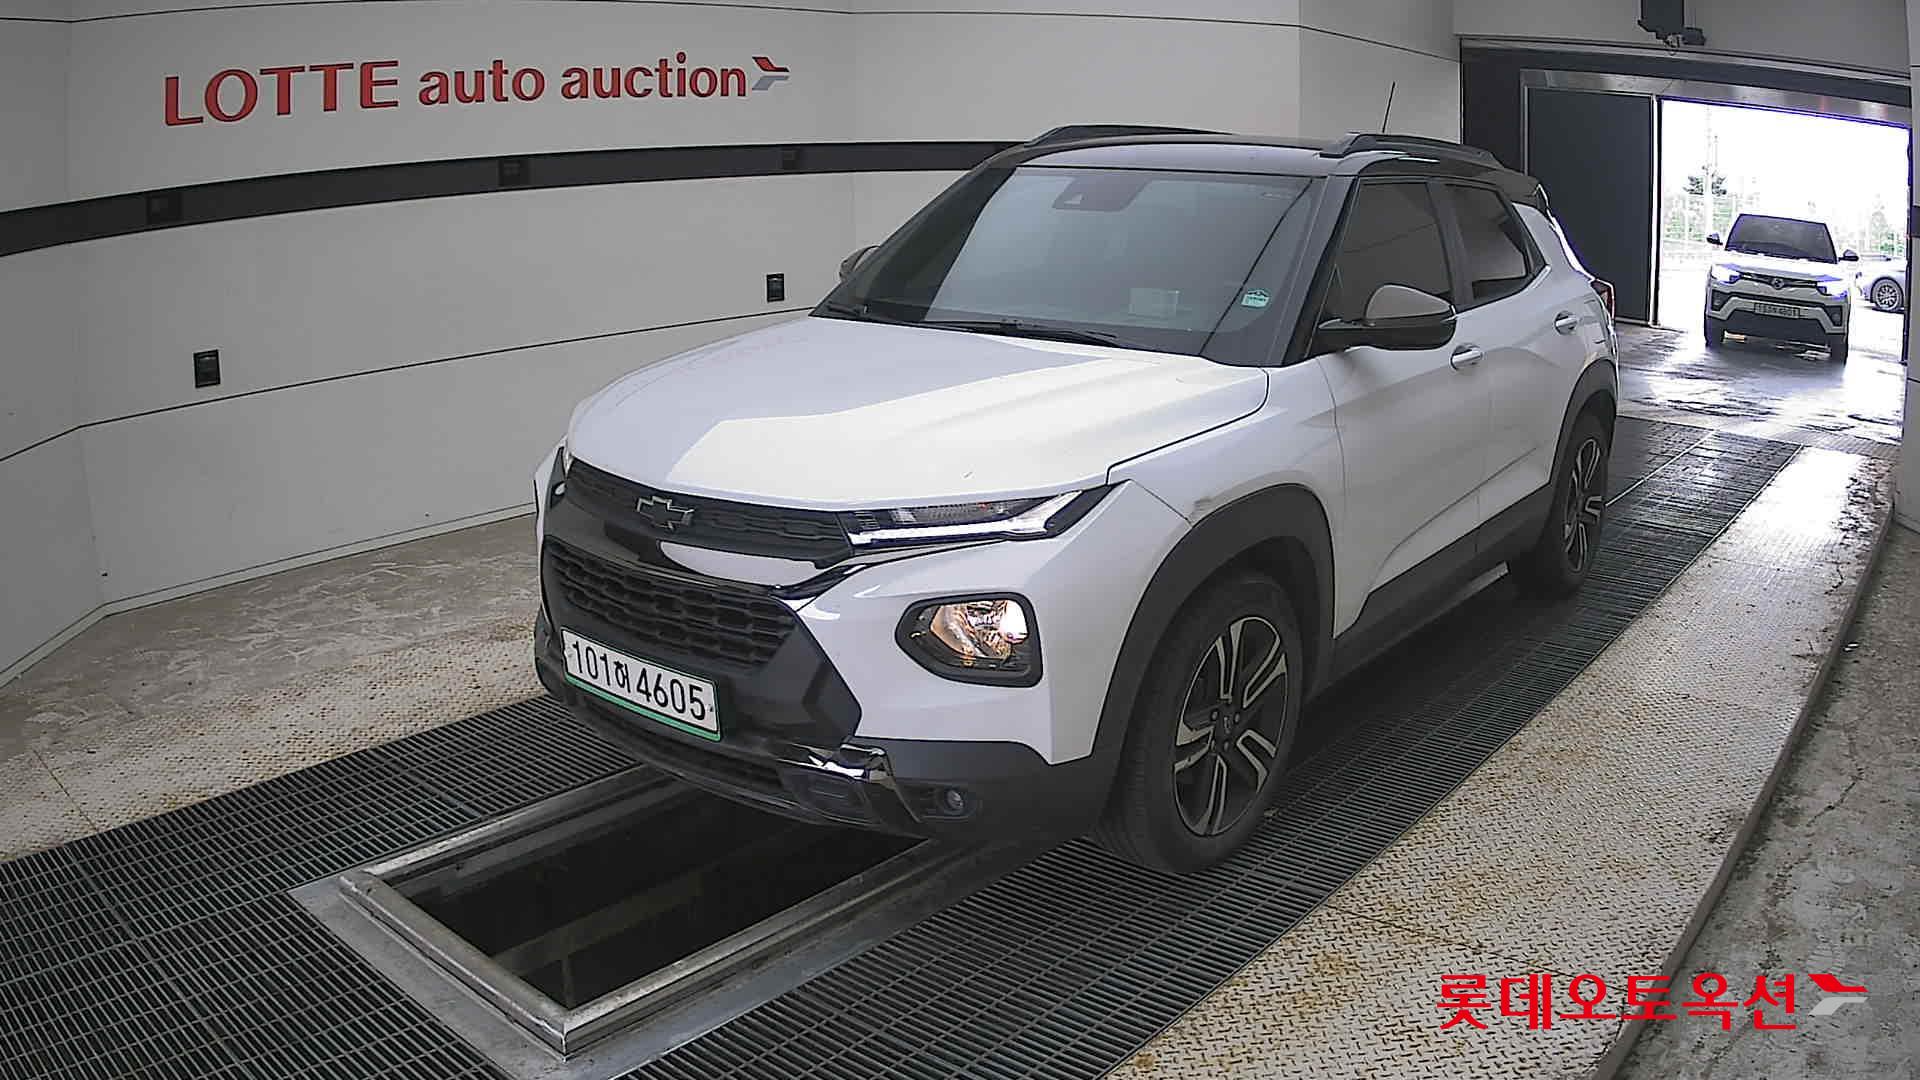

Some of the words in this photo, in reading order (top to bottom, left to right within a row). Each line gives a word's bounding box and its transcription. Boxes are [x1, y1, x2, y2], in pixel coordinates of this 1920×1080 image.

[164, 60, 399, 126] LOTTE
[418, 59, 546, 105] auto
[560, 51, 747, 98] auction
